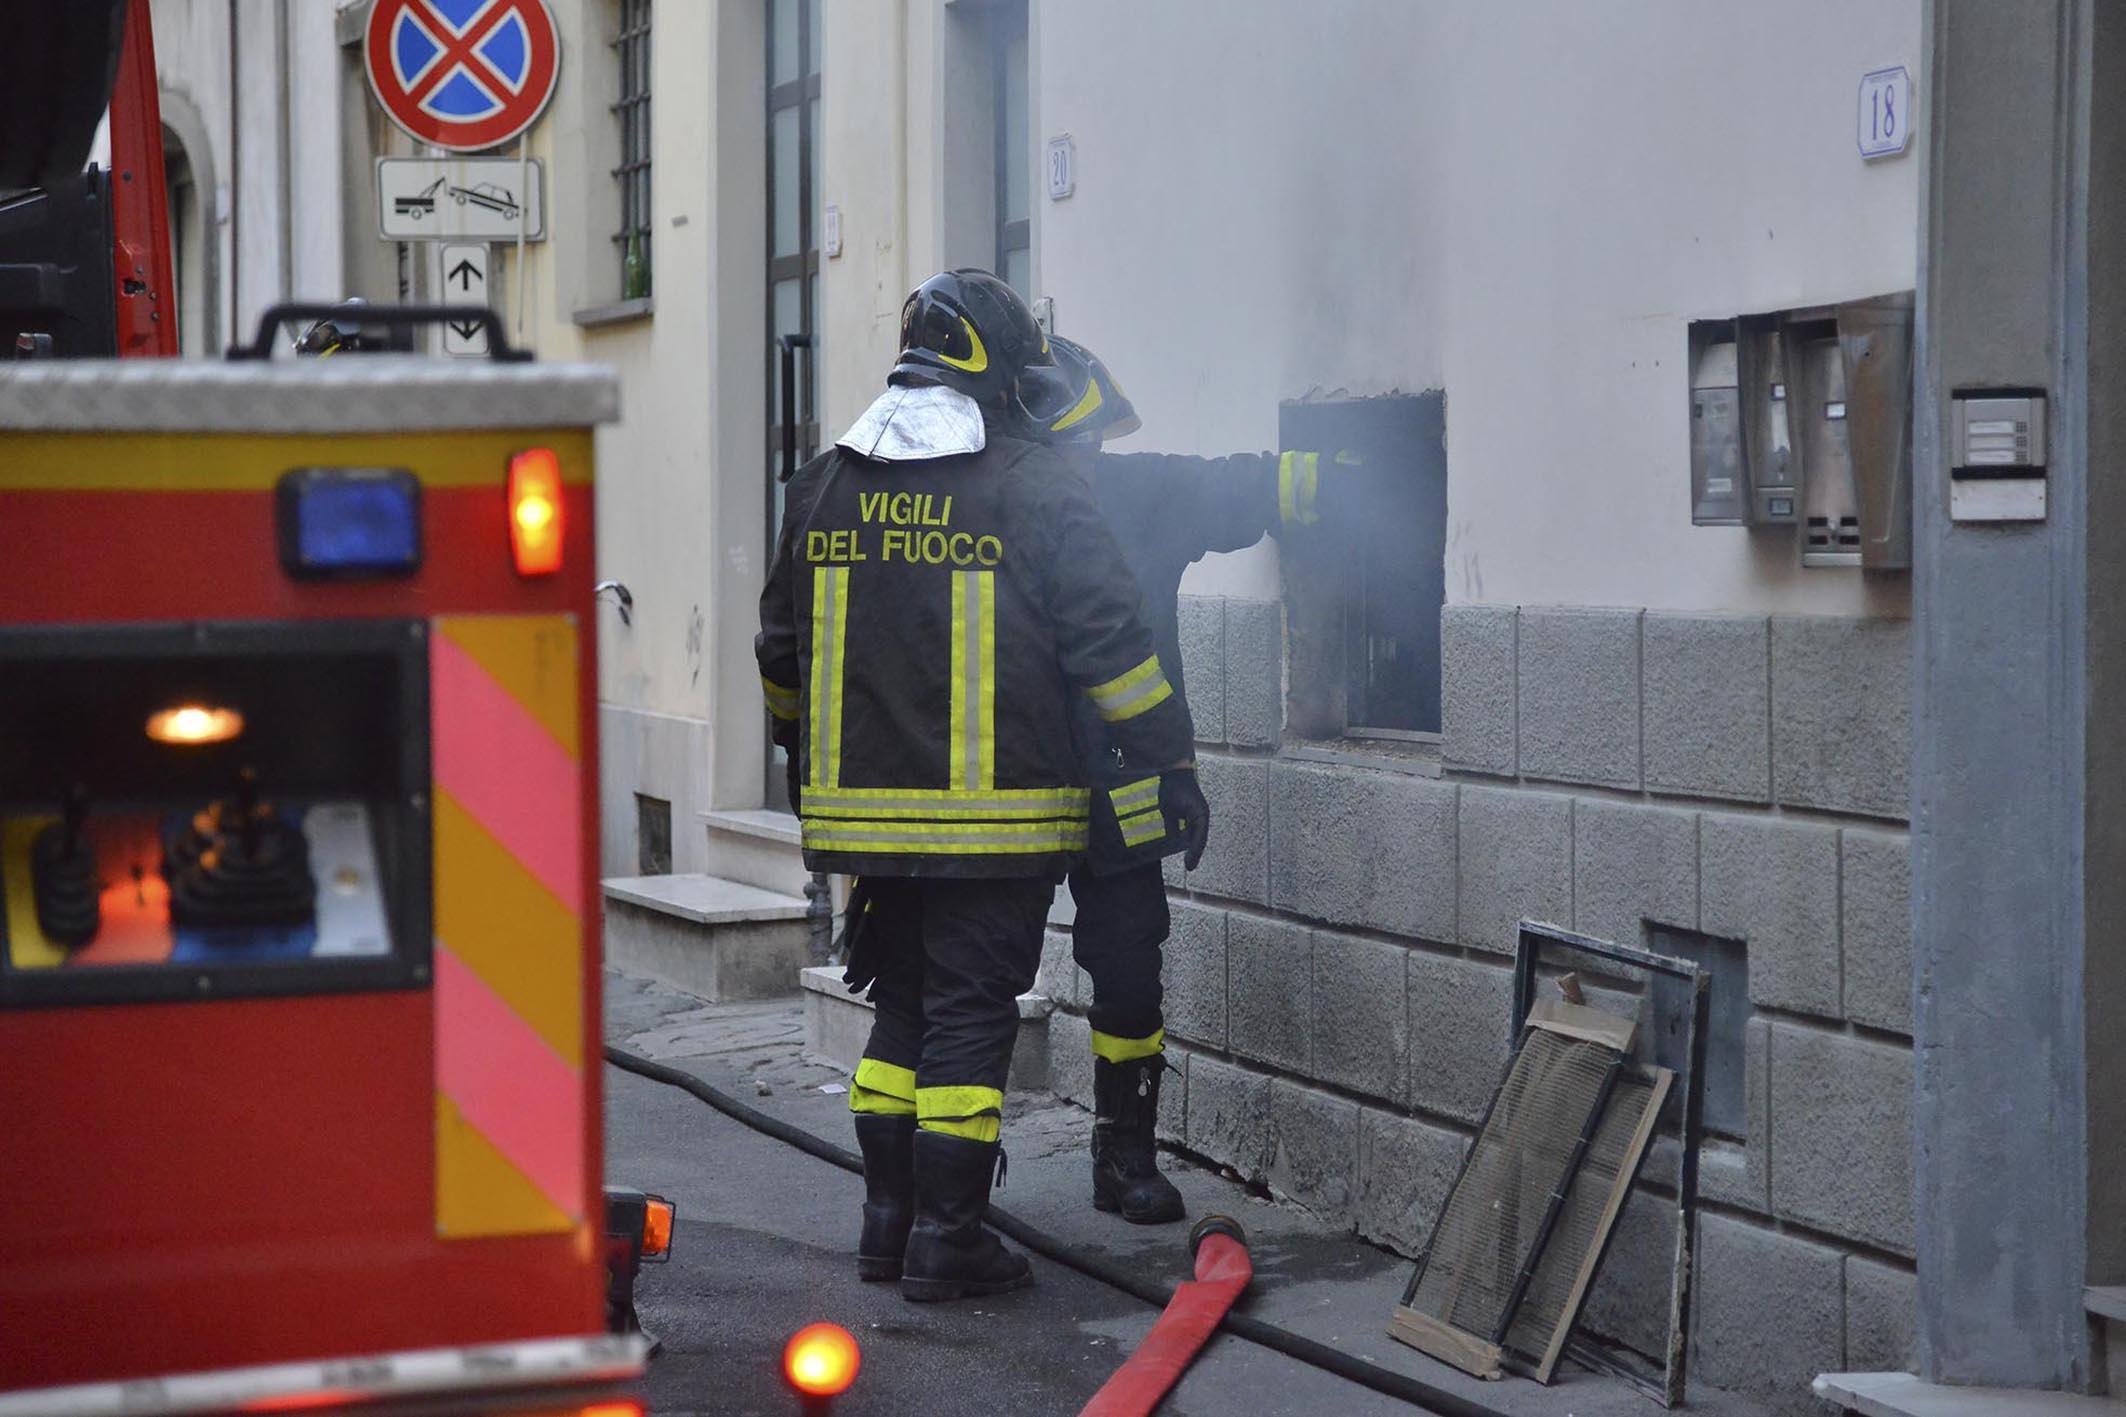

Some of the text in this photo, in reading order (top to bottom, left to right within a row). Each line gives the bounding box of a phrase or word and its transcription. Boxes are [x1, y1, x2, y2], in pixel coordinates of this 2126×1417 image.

[1872, 84, 1895, 141] 18
[859, 492, 952, 526] VIGILI
[806, 530, 1003, 566] DEL FUOCO
